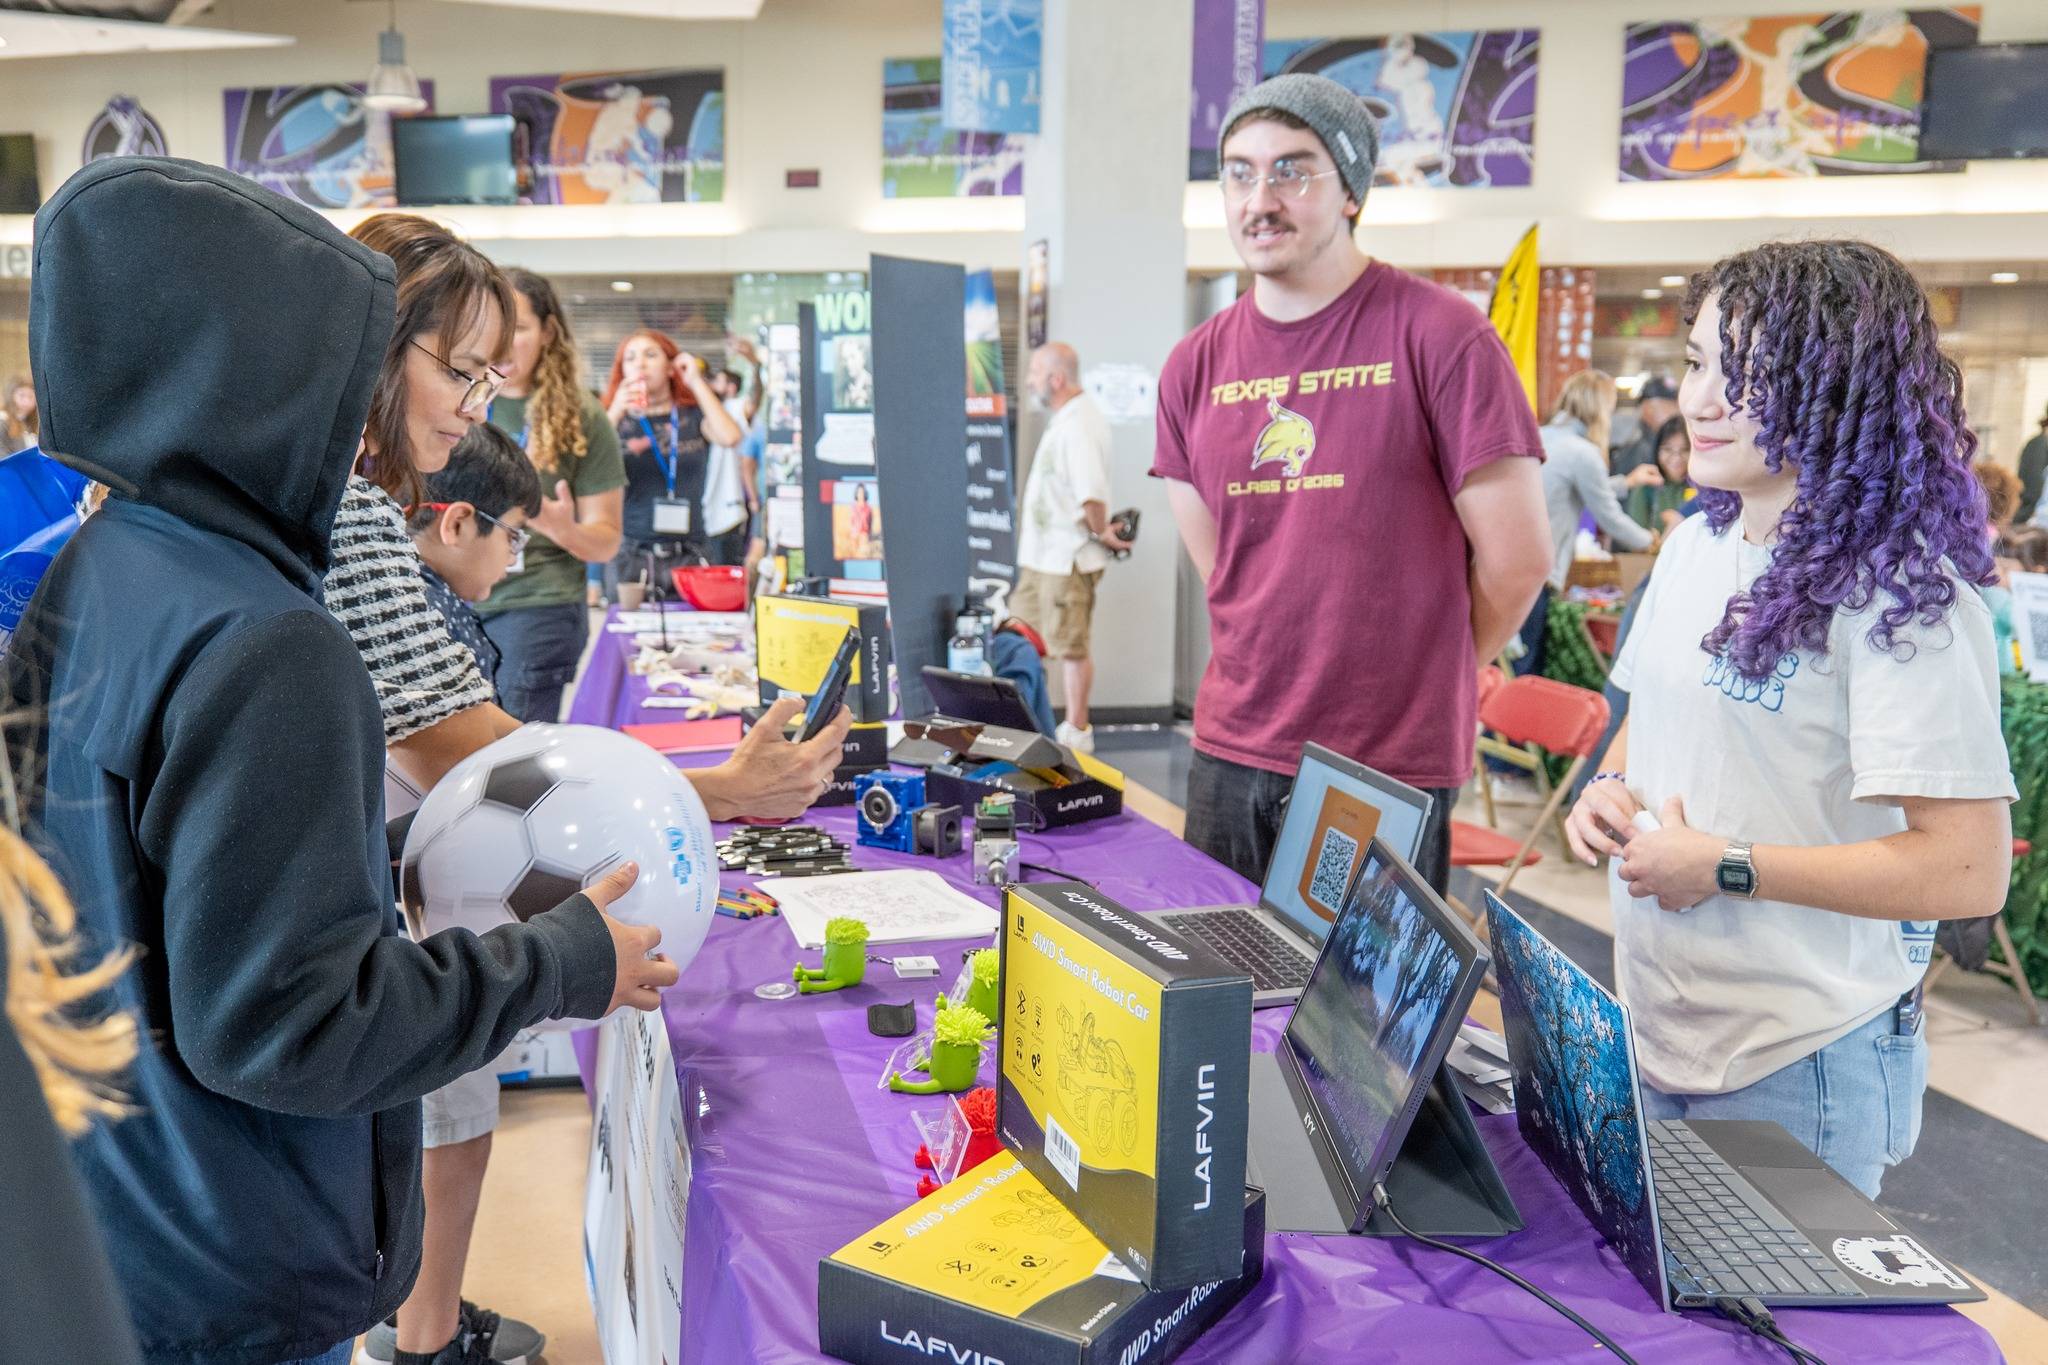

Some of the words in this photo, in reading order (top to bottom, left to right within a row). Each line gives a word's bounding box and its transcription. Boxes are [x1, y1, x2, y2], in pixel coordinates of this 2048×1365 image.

[1211, 375, 1290, 406] TEXAS
[1298, 361, 1393, 394] STATE
[1227, 479, 1281, 496] CLASS
[870, 636, 880, 694] LAFVIN
[1057, 794, 1103, 812] LAFVIN
[1062, 891, 1089, 904] Car
[1081, 901, 1119, 921] Robot
[1112, 916, 1157, 941] Smart
[1146, 940, 1190, 961] 4WD
[1032, 931, 1056, 959] 4WD
[1057, 947, 1088, 982] Smart
[1091, 968, 1125, 1007] Robot
[1127, 991, 1150, 1022] Car
[1193, 1064, 1216, 1211] LAFVIN
[1303, 1111, 1316, 1136] KYY
[905, 1211, 944, 1239] 4WD
[940, 1183, 991, 1216] Smart
[983, 1160, 1025, 1187] Robo
[880, 1320, 1006, 1365] LAFVIN
[1119, 1330, 1151, 1365] 4WD
[1153, 1296, 1190, 1343] Smart
